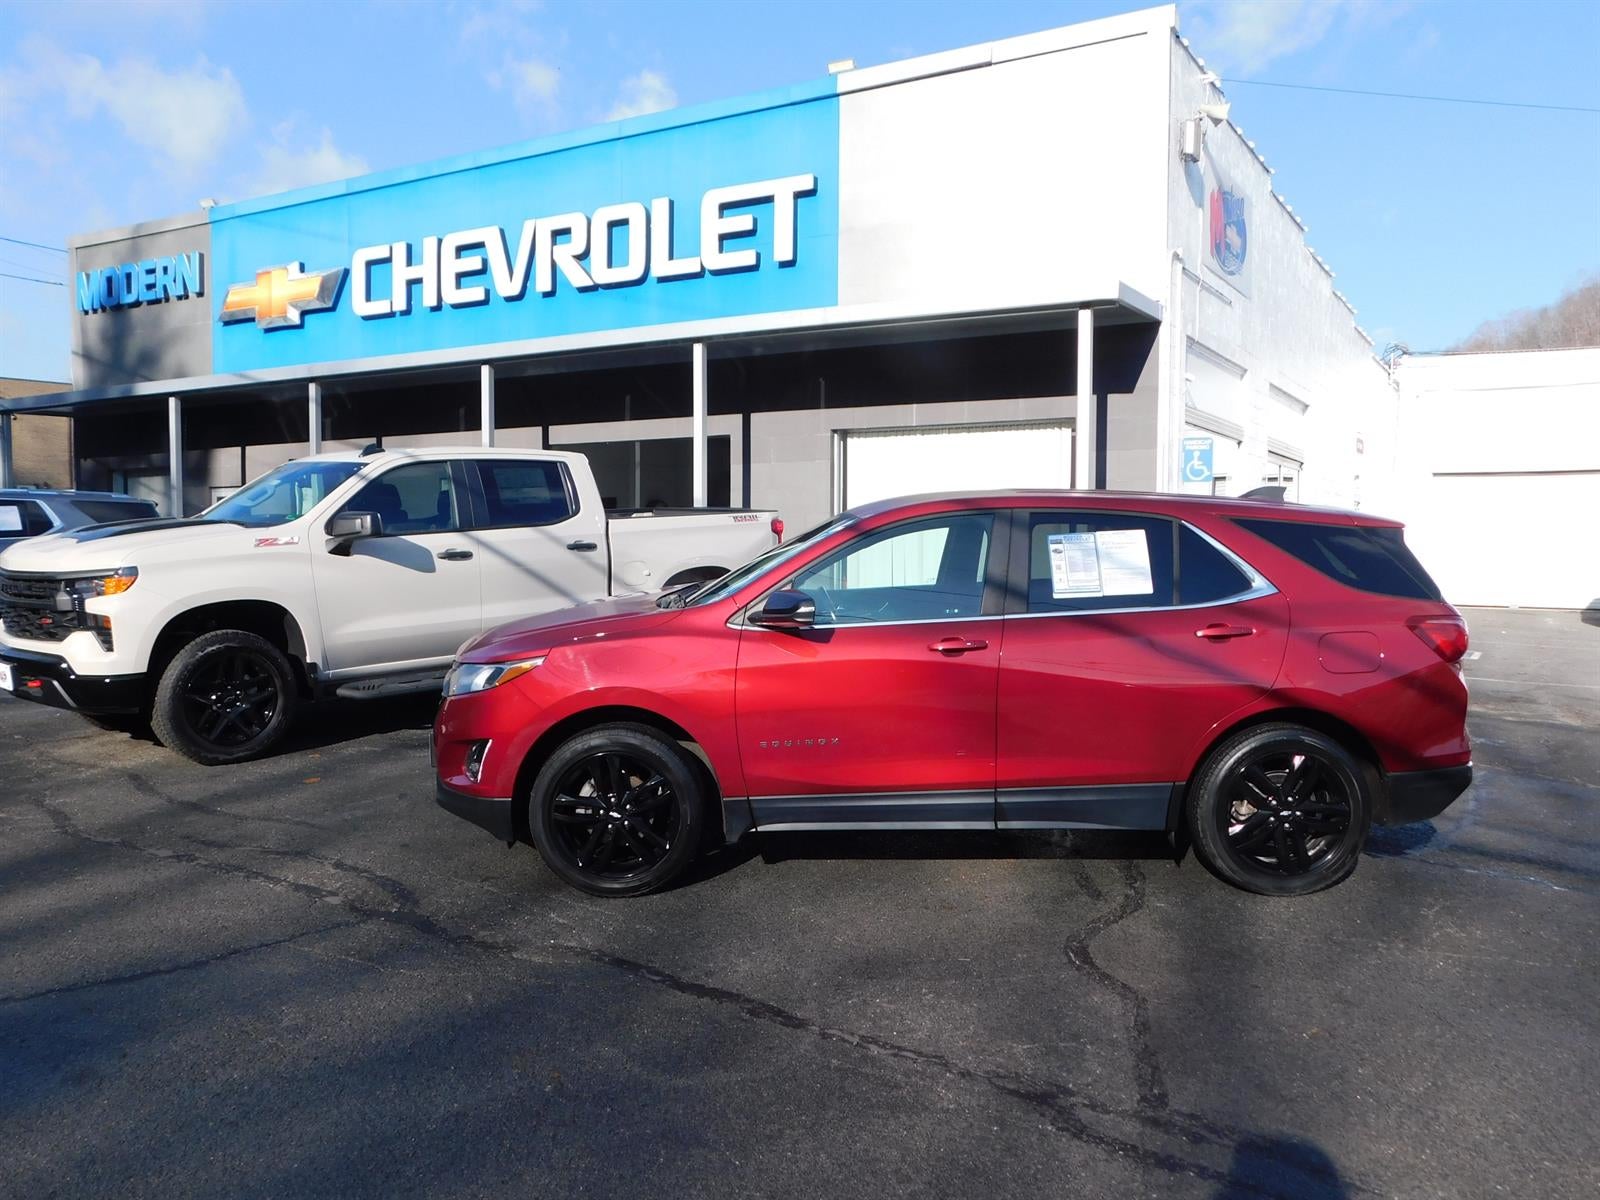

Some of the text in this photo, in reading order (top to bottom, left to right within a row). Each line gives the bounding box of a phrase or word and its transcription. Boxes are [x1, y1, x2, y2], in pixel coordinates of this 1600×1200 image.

[351, 173, 816, 317] CHEVROLET
[77, 252, 204, 312] MODERN
[759, 737, 839, 748] EQUINOX
